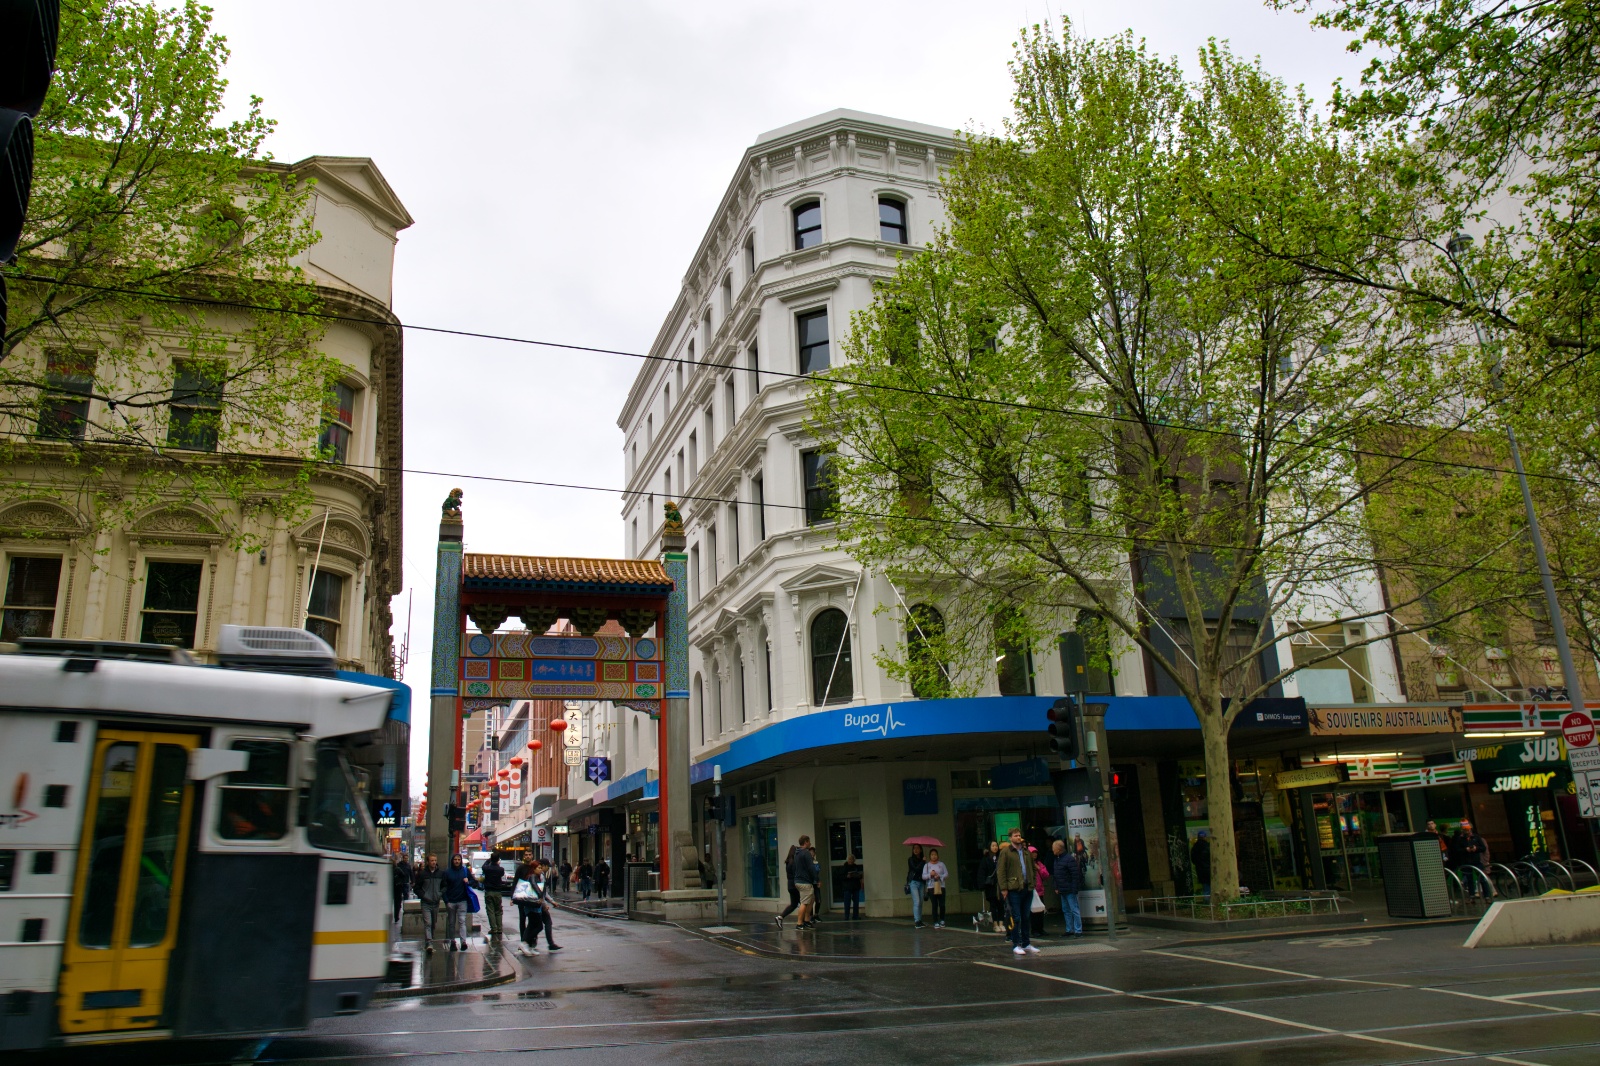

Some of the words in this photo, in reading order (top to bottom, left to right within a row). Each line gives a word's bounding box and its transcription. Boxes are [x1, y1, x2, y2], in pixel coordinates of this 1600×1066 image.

[844, 713, 880, 728] Bupa
[1326, 712, 1382, 728] SOUVENIRS
[1385, 710, 1449, 727] AUSTRALIANA
[1571, 717, 1582, 726] NO
[1568, 733, 1592, 743] ENTRY
[1457, 745, 1503, 762] SUBWAY
[1570, 750, 1599, 759] BICYCLES
[1492, 771, 1556, 792] SUBWAY
[377, 817, 395, 825] ANZ
[1526, 805, 1541, 854] SUBWAY
